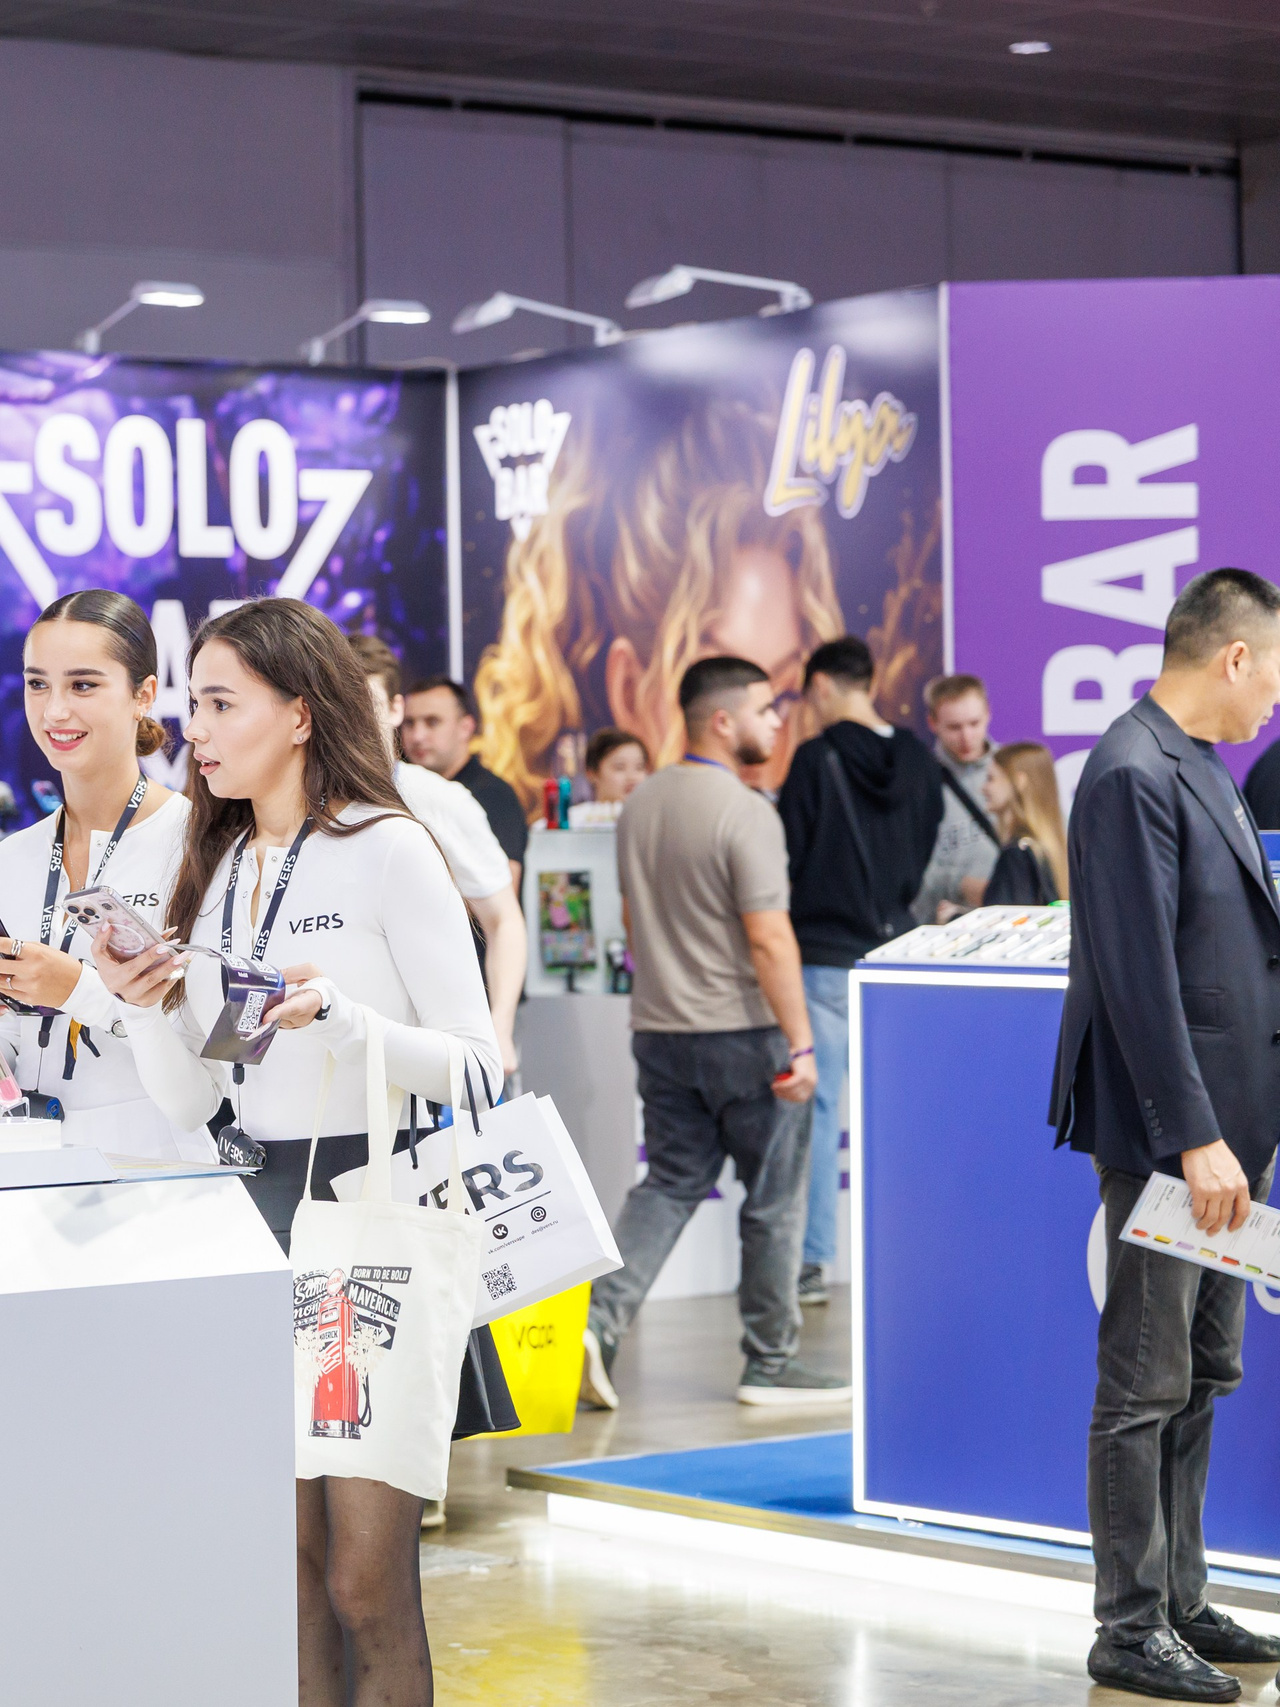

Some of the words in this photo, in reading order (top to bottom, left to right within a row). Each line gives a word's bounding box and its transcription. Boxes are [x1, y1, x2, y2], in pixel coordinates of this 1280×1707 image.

[34, 412, 299, 561] SOLO
[1040, 422, 1199, 825] BAR
[127, 780, 148, 809] VERS
[50, 843, 64, 872] VERS
[227, 855, 243, 891] VERS
[275, 854, 297, 891] VERS
[40, 905, 54, 939] VERS
[289, 912, 345, 935] VERS
[353, 1267, 371, 1279] BORN
[372, 1269, 381, 1279] TO
[381, 1270, 390, 1280] BE
[391, 1270, 409, 1281] BOLD
[348, 1283, 396, 1318] MAVERICK
